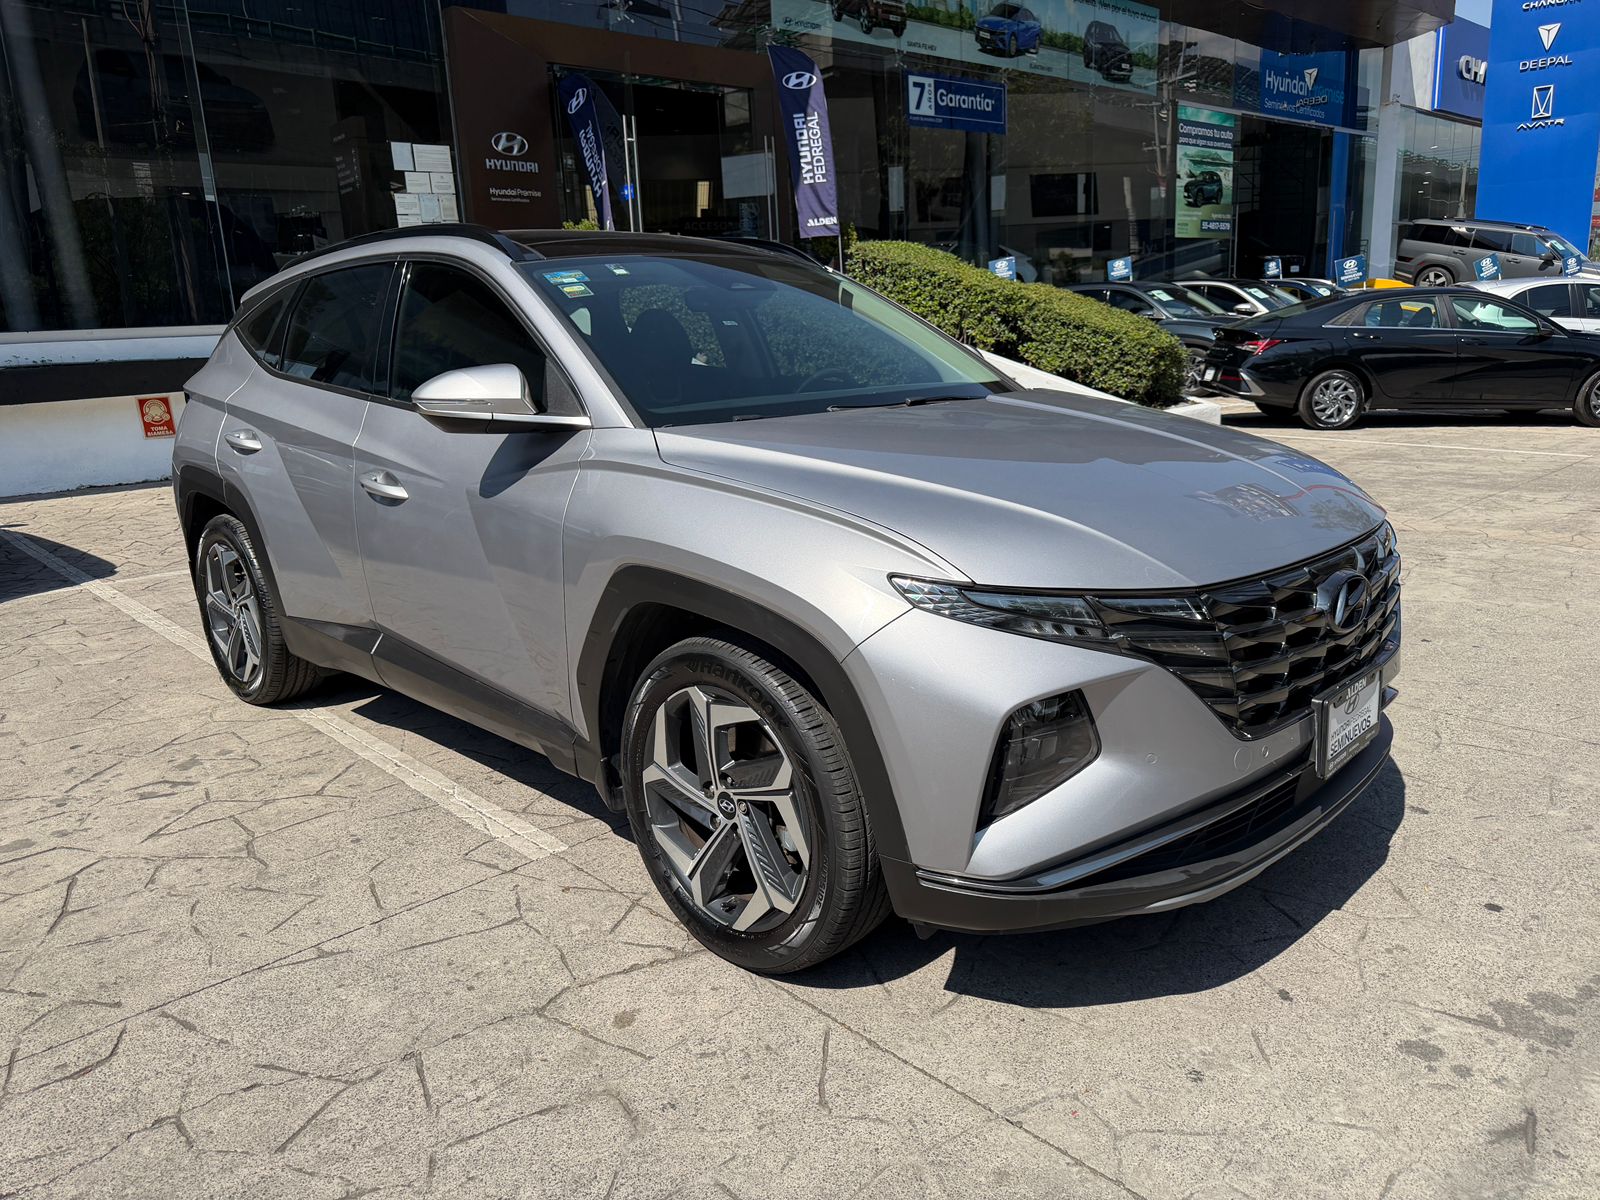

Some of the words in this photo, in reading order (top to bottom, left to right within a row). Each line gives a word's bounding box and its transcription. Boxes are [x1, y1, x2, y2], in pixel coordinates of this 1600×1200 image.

[1522, 0, 1570, 9] CHANG
[1520, 55, 1573, 70] DEEPAL
[912, 81, 926, 110] 7
[1179, 123, 1214, 137] Compramos
[1214, 129, 1220, 137] tu
[1221, 131, 1233, 140] auto
[1517, 119, 1565, 130] AVATR
[793, 113, 814, 184] HYUNDAI
[807, 112, 827, 183] PEDREGAL
[485, 158, 539, 173] HYUNDAI
[579, 129, 602, 198] HYUNDAI
[489, 187, 517, 196] Hyundai
[1331, 719, 1349, 741] HYUNDAI
[1331, 715, 1371, 757] SEMINUEVOS
